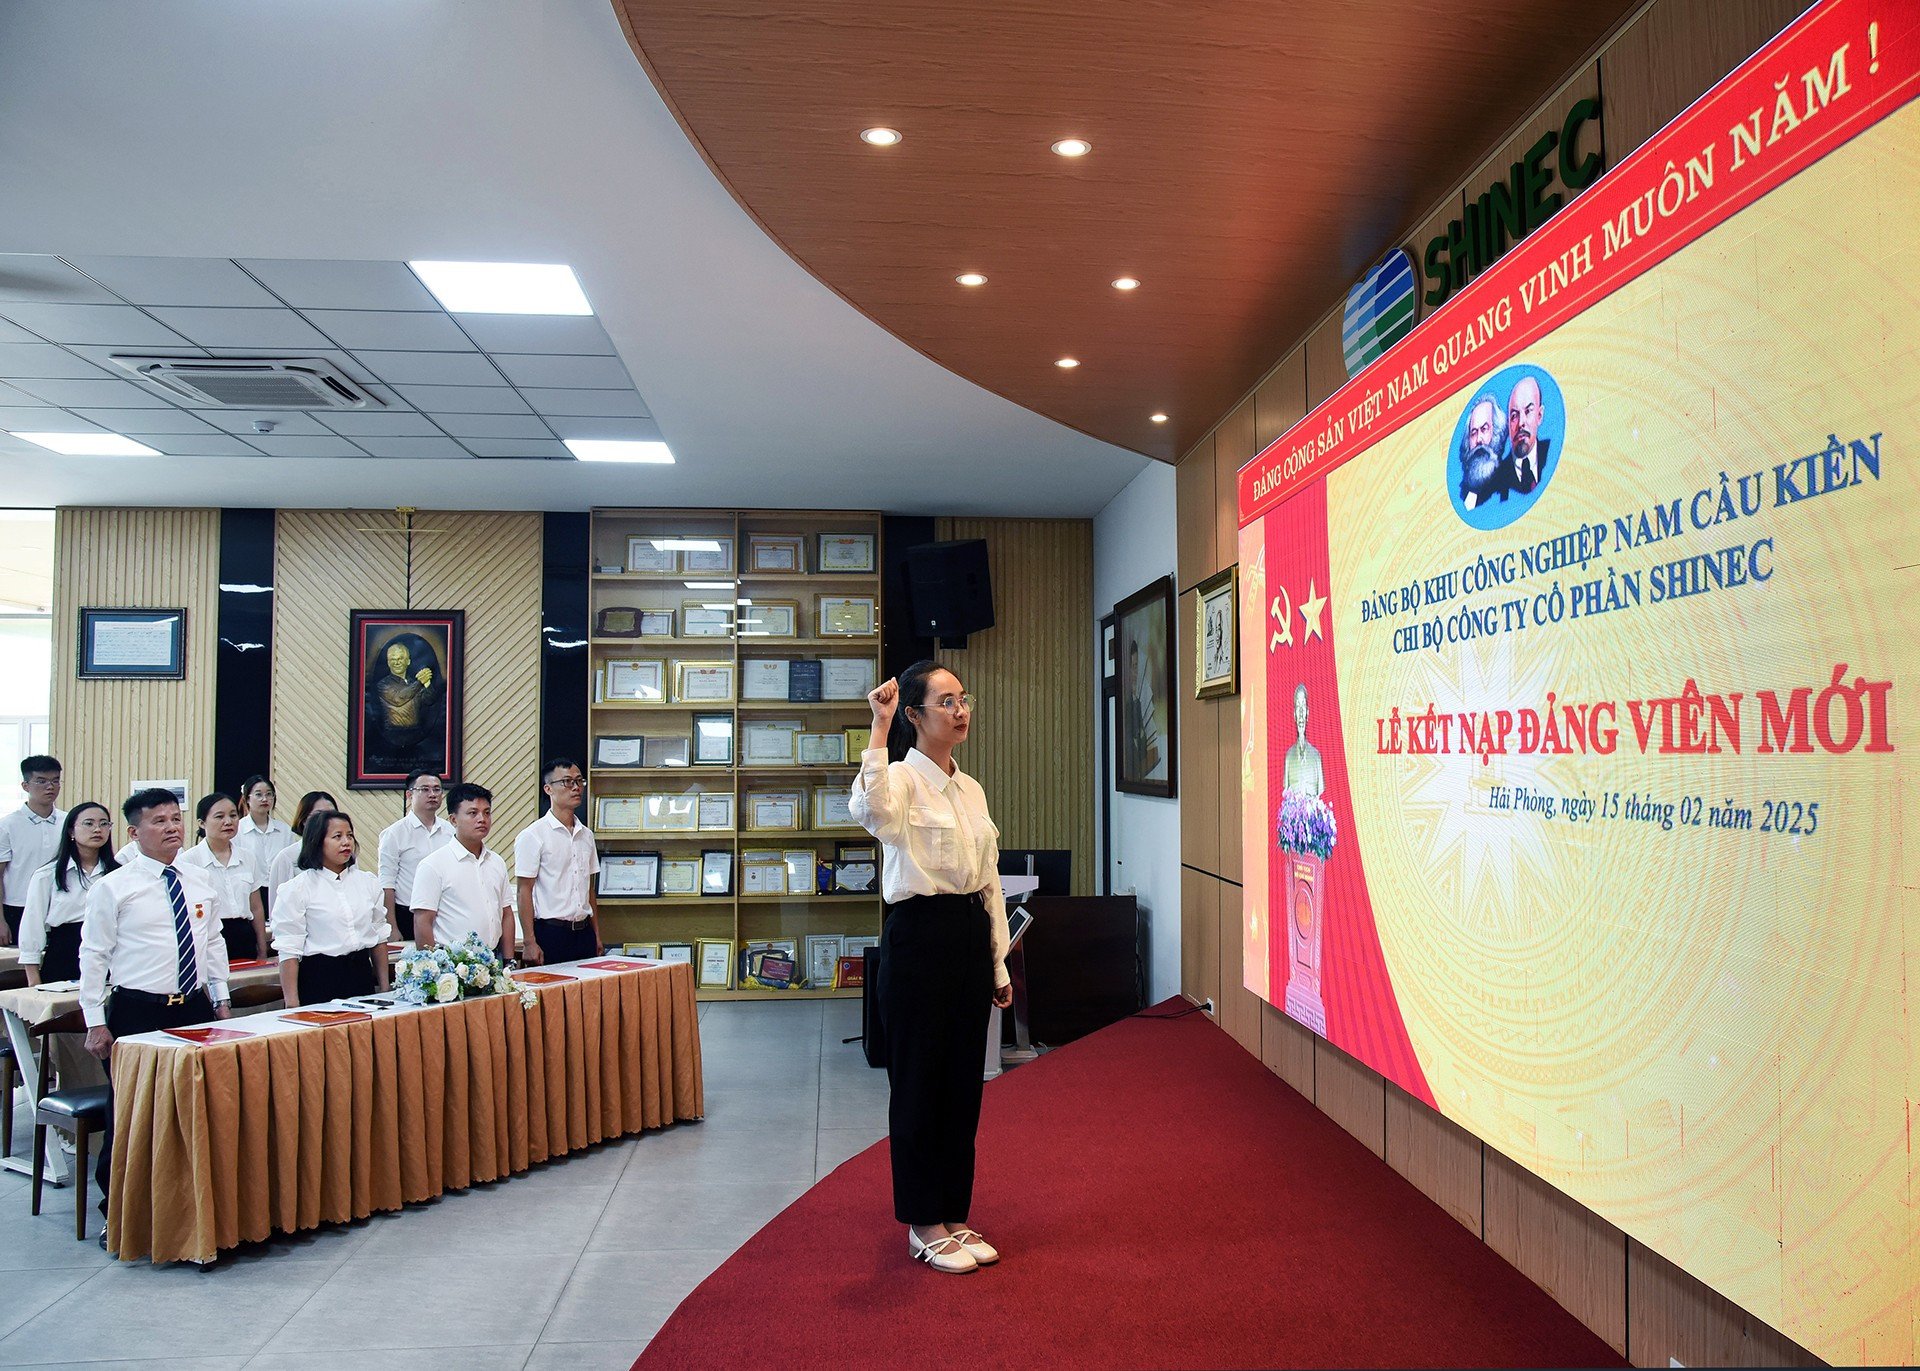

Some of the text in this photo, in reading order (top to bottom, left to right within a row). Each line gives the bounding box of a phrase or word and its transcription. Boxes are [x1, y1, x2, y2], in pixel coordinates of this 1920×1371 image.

[1253, 21, 1880, 501] ĐẢNG CỘNG SẢN VIỆT NAM QUANG VINH MUÔN NĂM !
[1424, 98, 1600, 307] SHINEC
[1361, 431, 1883, 623] ĐẢNG BỘ KHU CÔNG NGHIỆP NAM CẦU KIỀN
[1393, 537, 1775, 654] CHI BỘ CÔNG TY CỔ PHẦN SHINEC
[1377, 663, 1895, 766] LỄ KẾT NẠP ĐẢNG VIÊN MỚI
[1489, 786, 1820, 835] Hải Phòng, ngày 15 tháng 02 năm 2025
